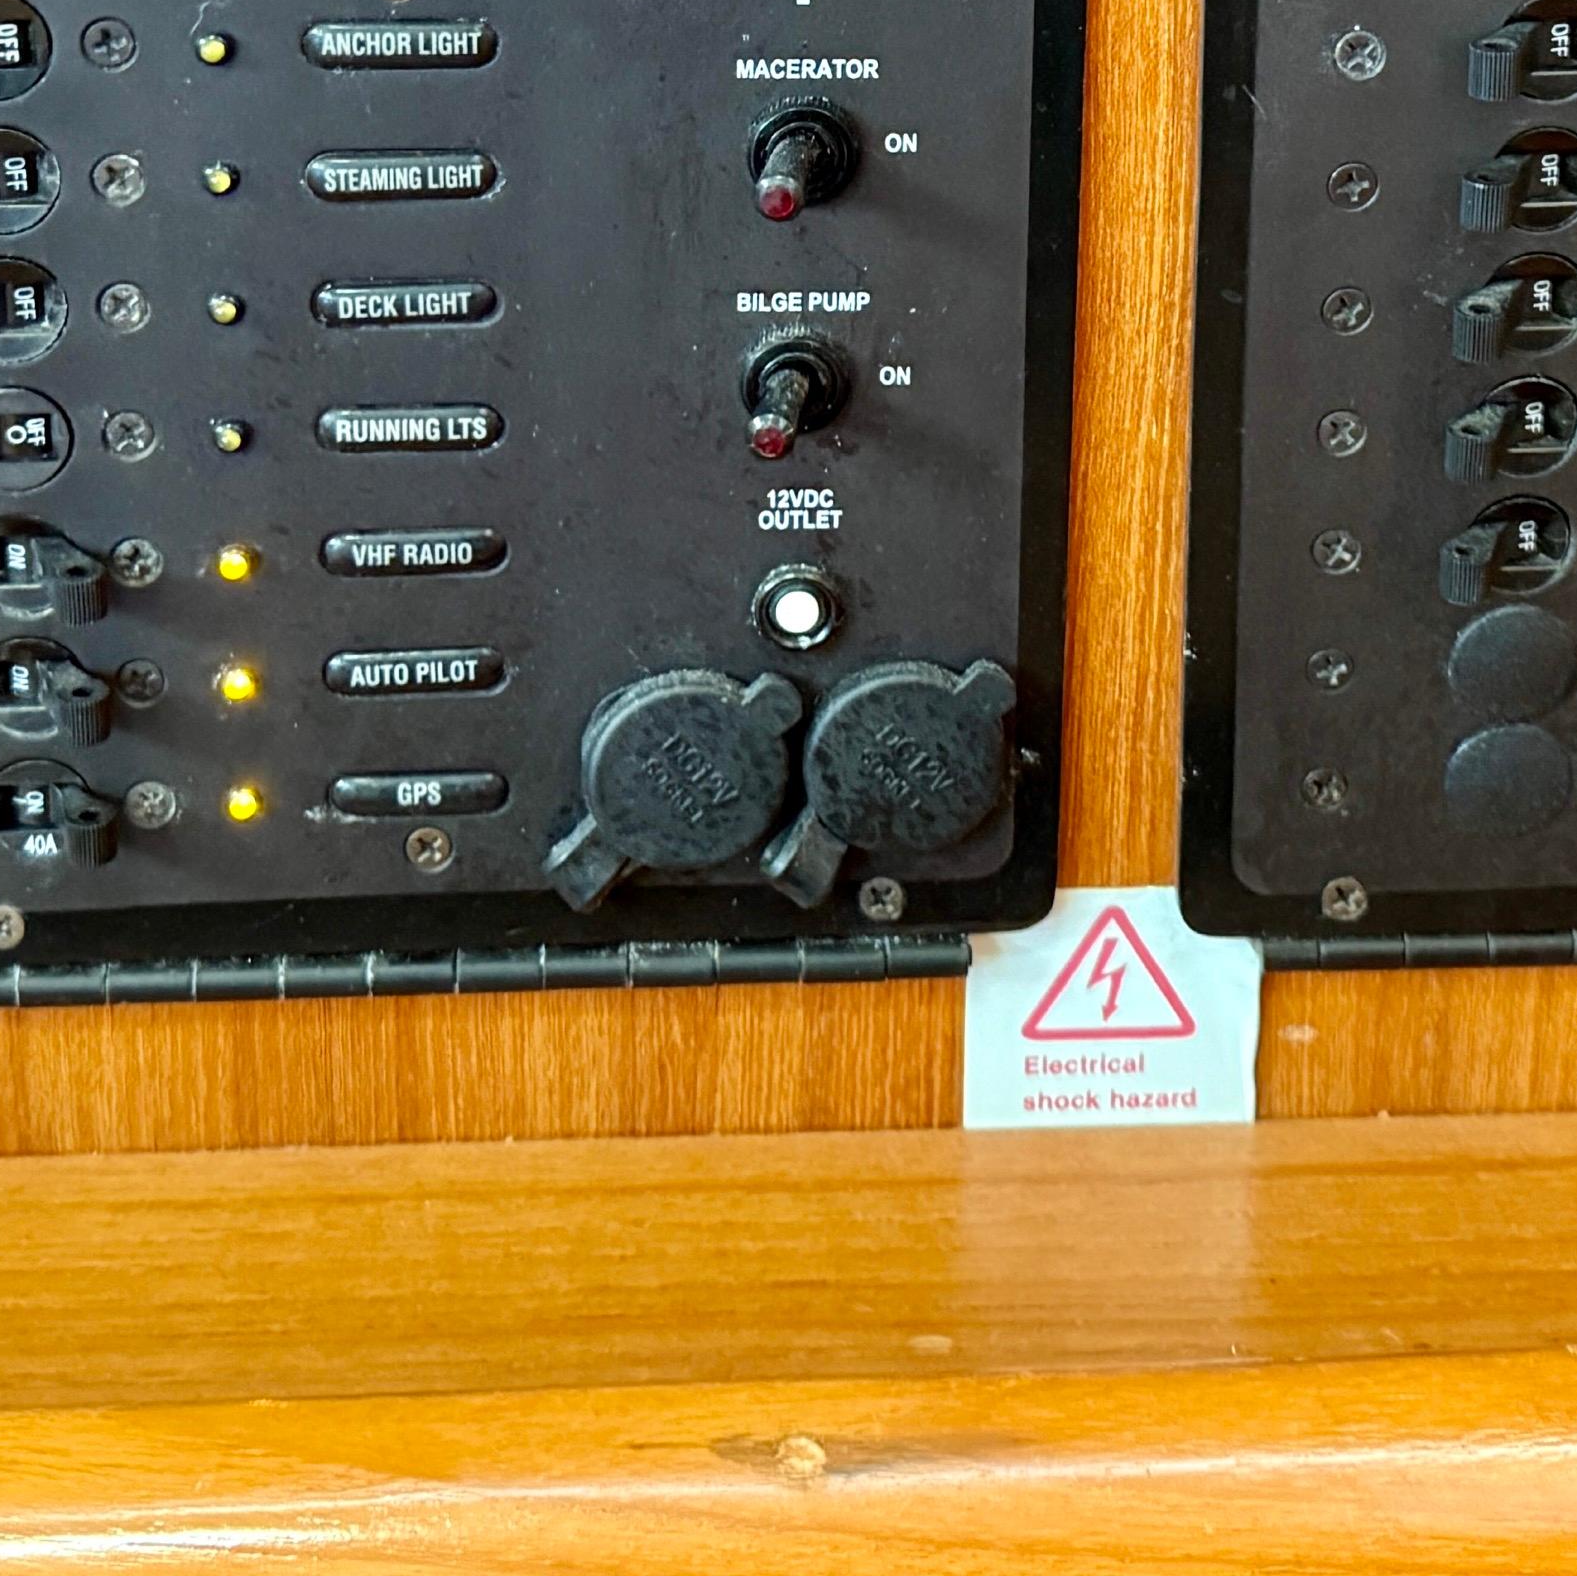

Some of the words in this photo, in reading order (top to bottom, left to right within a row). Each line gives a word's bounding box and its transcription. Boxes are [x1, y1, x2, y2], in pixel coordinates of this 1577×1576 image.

[321, 32, 413, 56] ANCHOR
[418, 31, 481, 55] LIGHT
[1551, 24, 1569, 58] OFF
[736, 58, 879, 79] MACERATOR
[885, 133, 918, 153] ON
[4, 156, 28, 192] OFF
[324, 168, 423, 193] STEAMING
[427, 165, 483, 190] LIGHT
[1542, 154, 1558, 187] OFF
[14, 286, 36, 321] OFF
[338, 295, 397, 319] DECK
[405, 293, 472, 316] LIGHT
[737, 292, 803, 312] BILGE
[808, 292, 871, 312] PUMP
[1534, 279, 1550, 312] OFF
[879, 367, 911, 386] ON
[335, 418, 441, 442] RUNNING
[446, 417, 487, 441] LTS
[1525, 402, 1542, 434] OFF
[767, 489, 834, 509] 12VDC
[759, 511, 843, 529] OUTLET
[1518, 522, 1534, 552] OFF
[8, 544, 26, 570] ON
[352, 544, 397, 566] VHF
[403, 542, 472, 565] RADIO
[12, 665, 28, 691] ON
[350, 662, 410, 686] AUTO
[415, 660, 478, 684] PILOT
[397, 782, 442, 807] GPS
[24, 834, 58, 855] 40A
[1024, 1053, 1145, 1075] Electrical
[1024, 1089, 1099, 1111] shock
[1110, 1087, 1197, 1109] hazard
